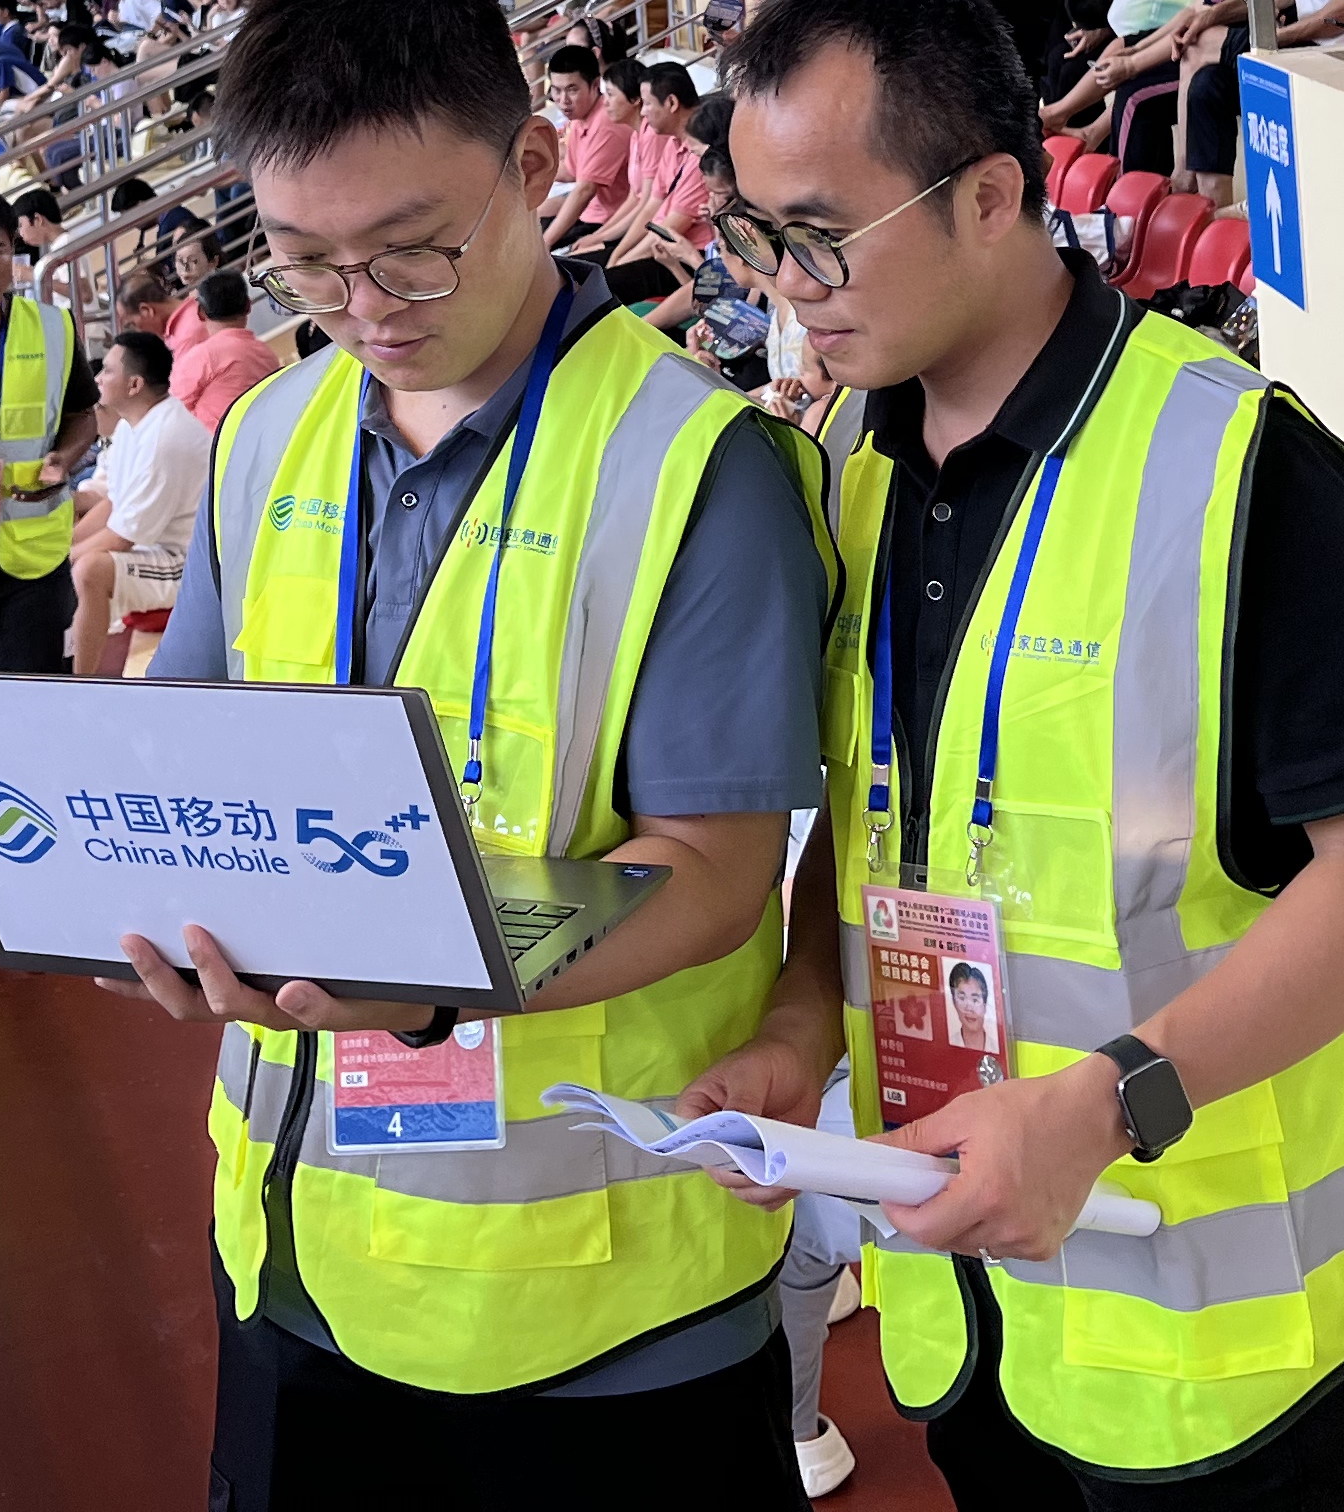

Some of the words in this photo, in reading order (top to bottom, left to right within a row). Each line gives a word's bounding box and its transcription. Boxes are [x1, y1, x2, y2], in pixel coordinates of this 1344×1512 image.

[1247, 112, 1290, 168] 观众座席
[1011, 634, 1101, 658] 家应急通信
[65, 789, 278, 843] 中国移动
[84, 837, 177, 867] China
[183, 844, 291, 875] Mobile
[345, 1074, 363, 1085] SLK
[387, 1111, 404, 1138] 4
